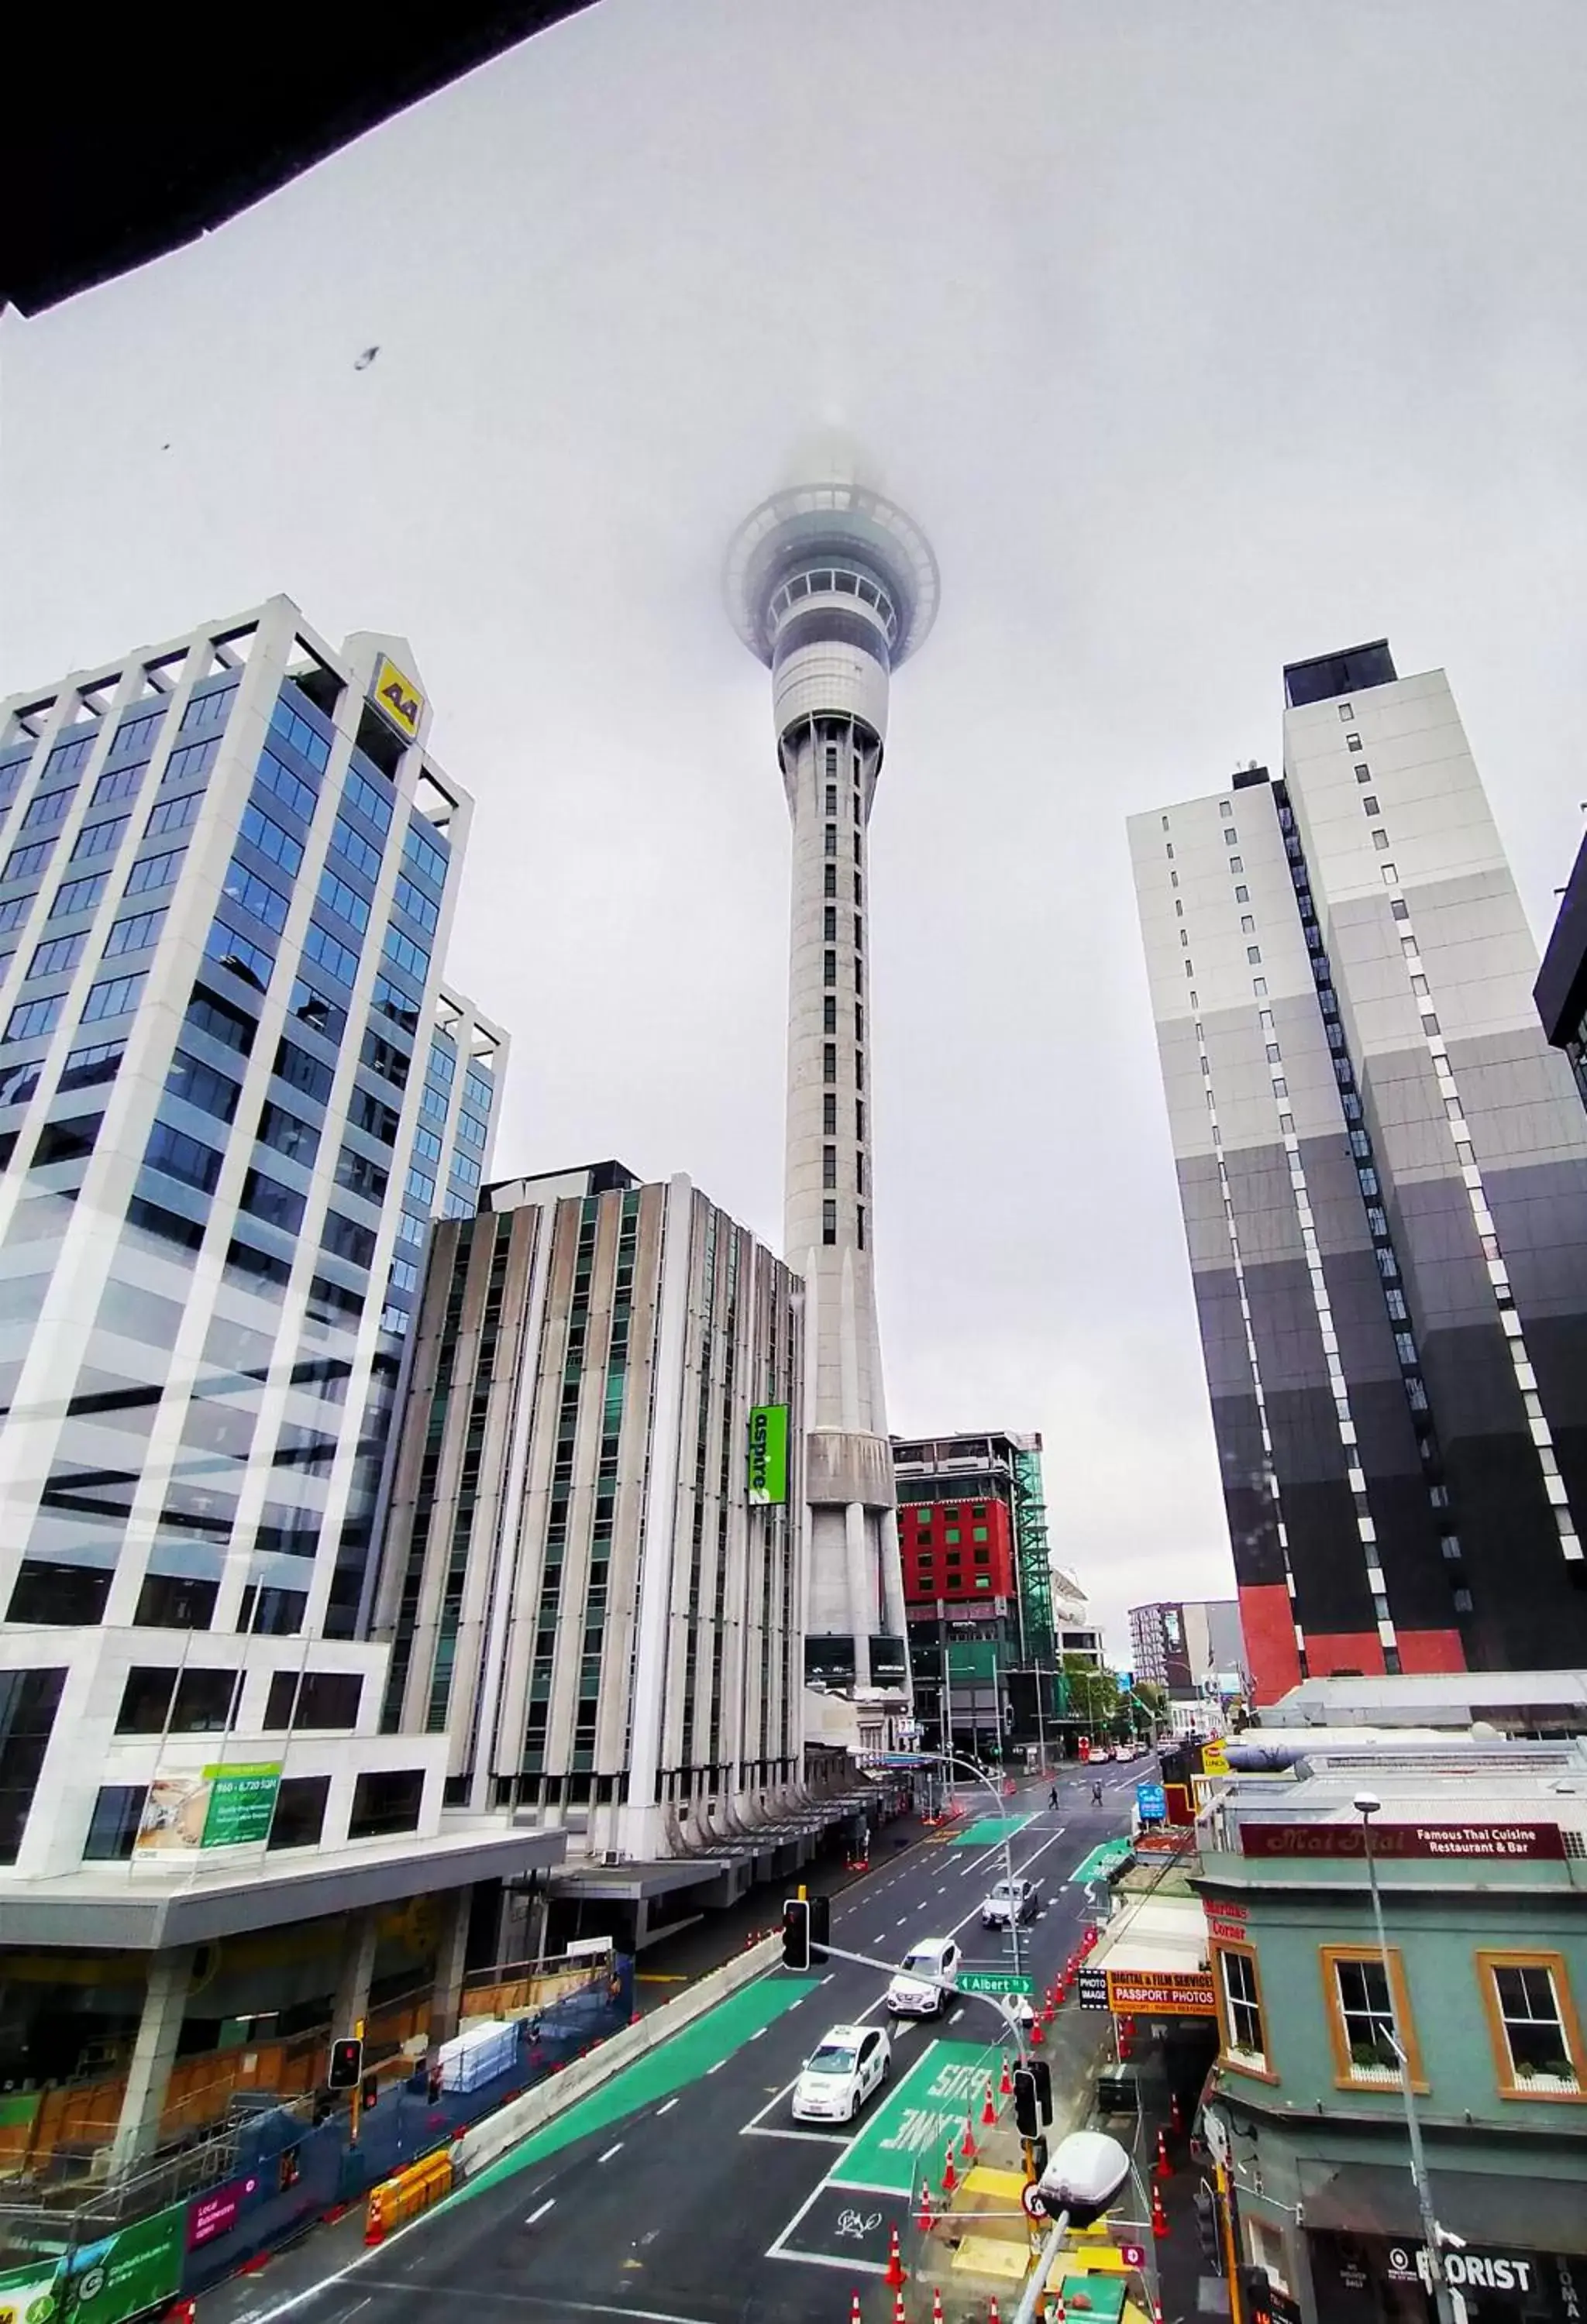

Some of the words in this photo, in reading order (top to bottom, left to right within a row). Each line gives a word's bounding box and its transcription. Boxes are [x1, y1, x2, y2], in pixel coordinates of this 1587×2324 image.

[381, 682, 418, 725] AA
[1417, 1829, 1462, 1840] Famous
[1463, 1829, 1489, 1840] Thai
[1492, 1829, 1536, 1841] Cuisine
[1430, 1841, 1494, 1853] Restaurant
[1496, 1842, 1505, 1852] &
[1508, 1842, 1528, 1852] Bar
[972, 1977, 1010, 1991] Albert
[1080, 1978, 1106, 1988] PHOTO
[1153, 1974, 1172, 1986] FILM
[1081, 1990, 1107, 1999] IMAGE
[1116, 1989, 1168, 2001] PASSPORT
[1172, 1990, 1213, 2003] PHOTOS
[927, 2064, 994, 2101] BUS
[879, 2107, 970, 2154] LANE
[198, 2199, 218, 2217] Local
[1417, 2250, 1530, 2291] FORIST
